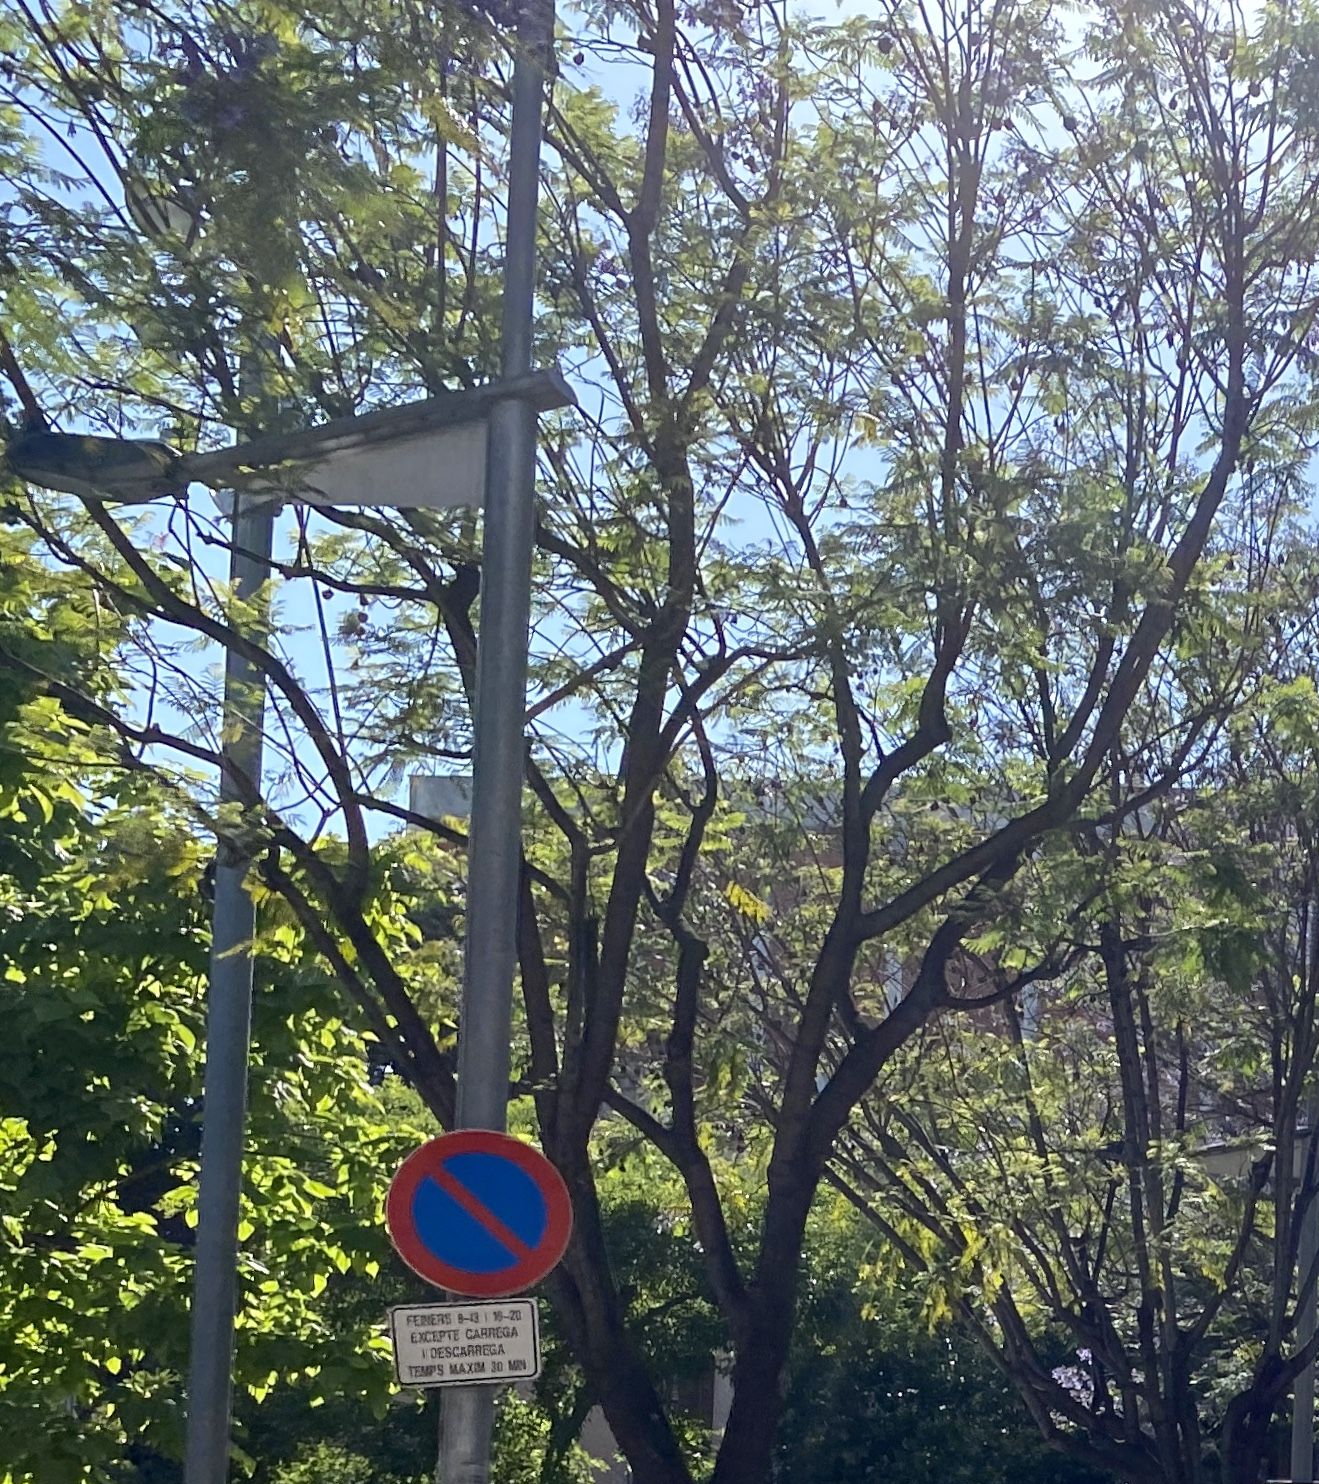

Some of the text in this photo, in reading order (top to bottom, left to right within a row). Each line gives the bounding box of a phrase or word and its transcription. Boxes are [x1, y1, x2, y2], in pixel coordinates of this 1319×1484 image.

[410, 1329, 460, 1344] EXCEPTE
[430, 1343, 506, 1359] DESCARREGA
[407, 1363, 444, 1378] TEMPS
